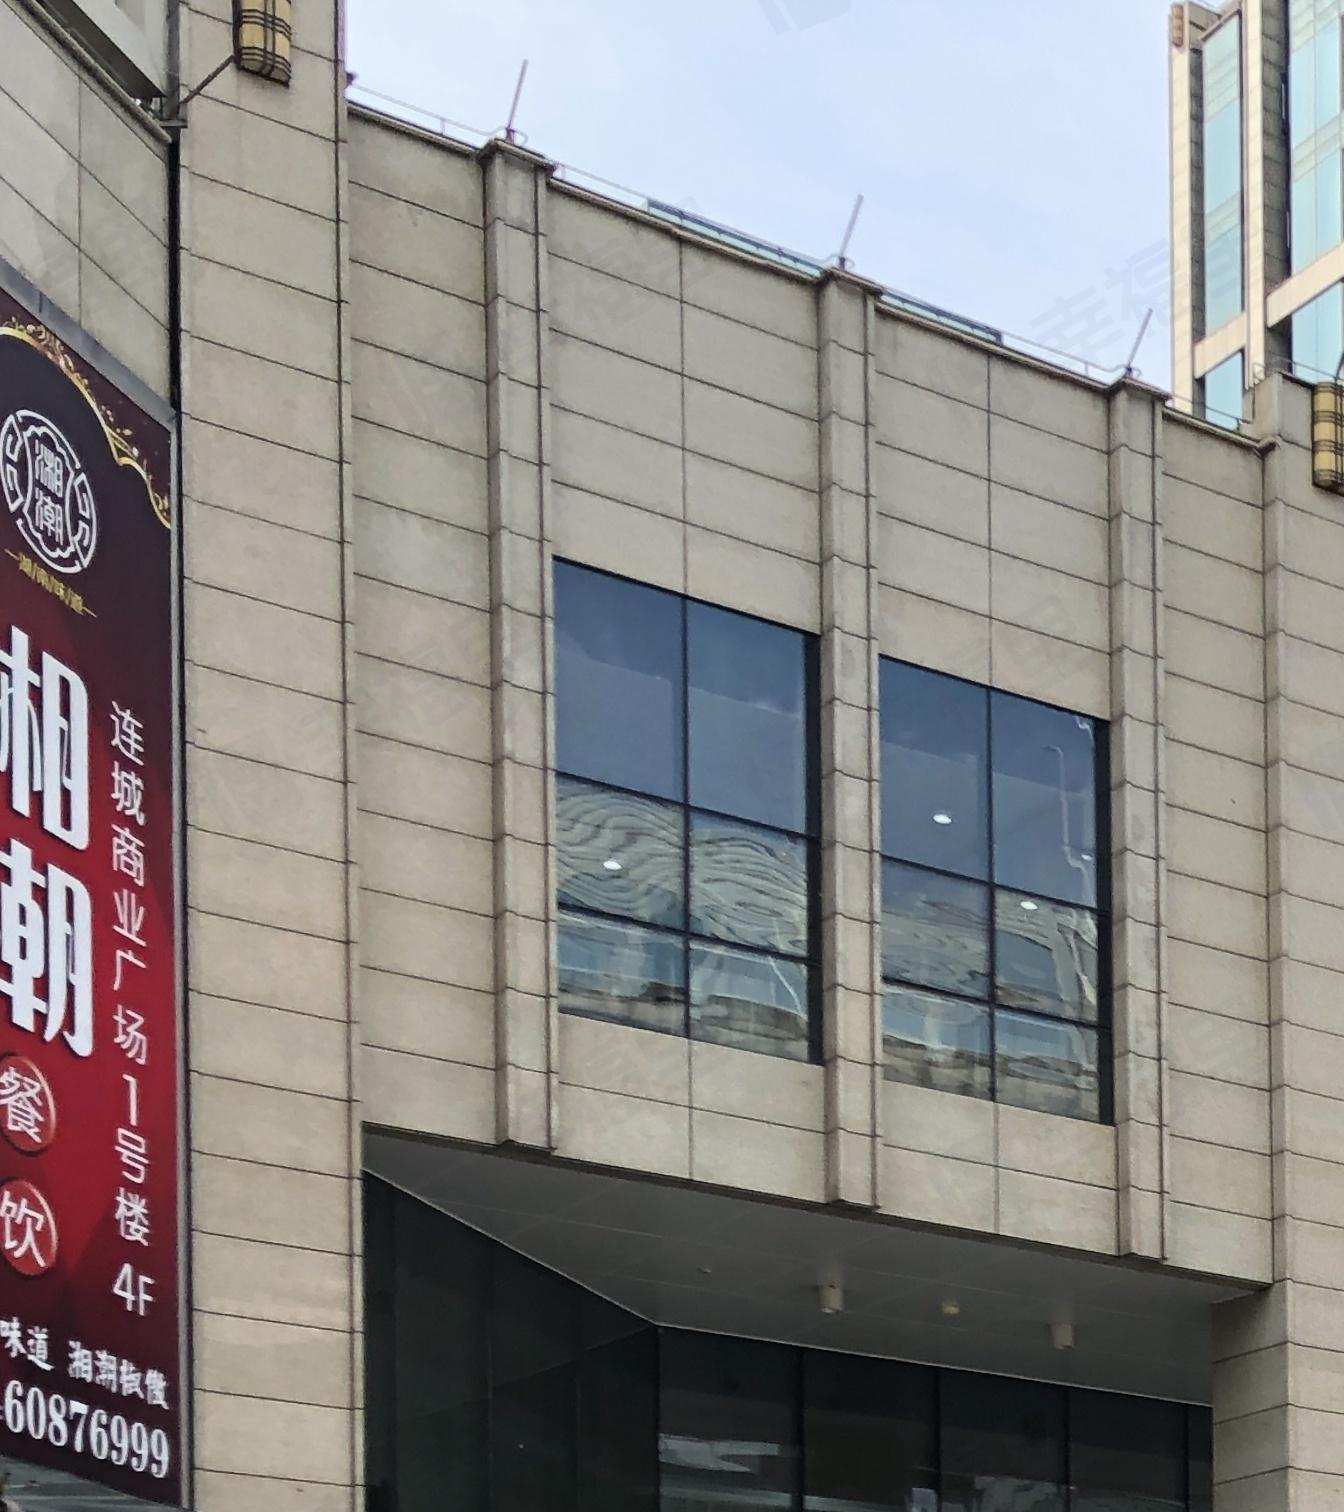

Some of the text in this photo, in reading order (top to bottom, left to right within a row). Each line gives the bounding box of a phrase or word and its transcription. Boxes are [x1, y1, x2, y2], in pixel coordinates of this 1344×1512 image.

[110, 701, 155, 1317] 连城商业广场1号楼 4F
[4, 1380, 170, 1479] 60876999
